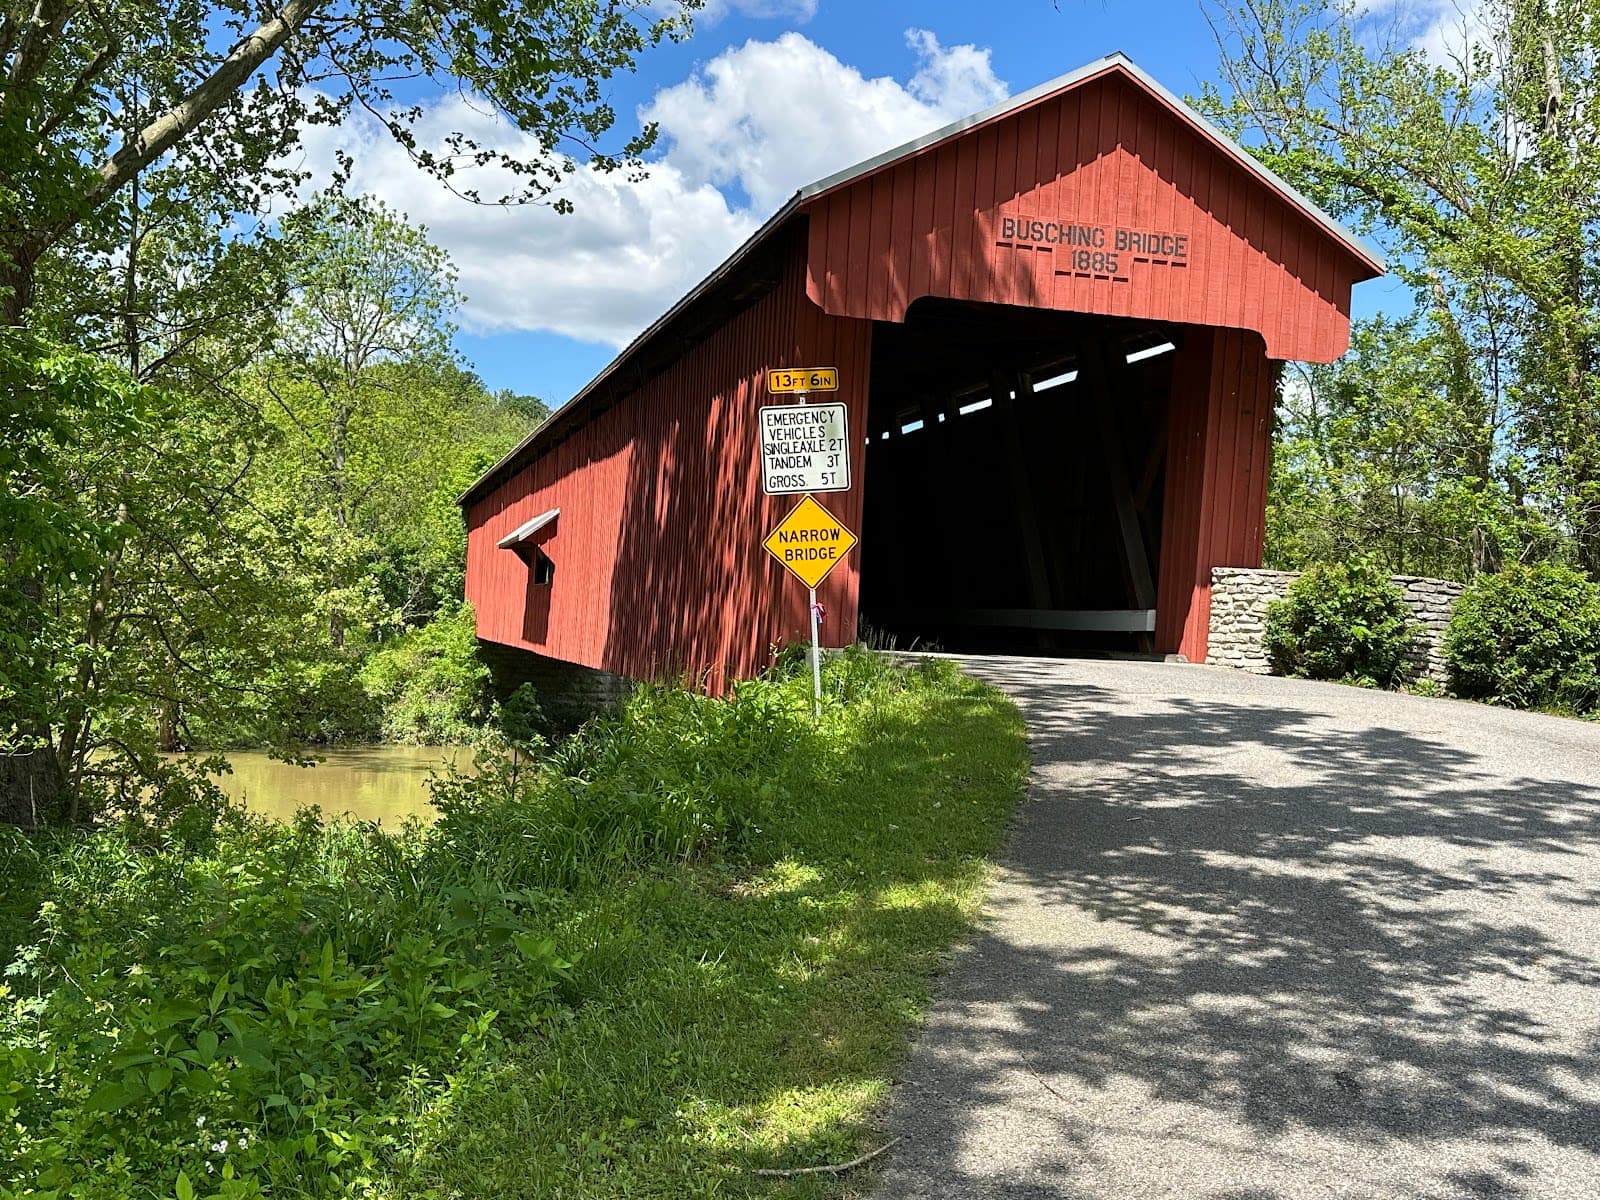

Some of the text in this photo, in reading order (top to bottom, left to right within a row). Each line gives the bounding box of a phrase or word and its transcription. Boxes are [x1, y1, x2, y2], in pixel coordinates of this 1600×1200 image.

[1002, 217, 1188, 258] BUSCHING BRIDGE
[1071, 250, 1119, 274] 1885
[810, 373, 831, 386] 6IN
[767, 410, 835, 426] EMERGENCY
[769, 425, 825, 441] VEHICLES
[829, 438, 843, 451] 2T
[769, 454, 840, 470] TANDEM 3T
[821, 472, 836, 485] 5T
[779, 528, 840, 543] NARROW
[785, 546, 837, 561] BRIDGE
